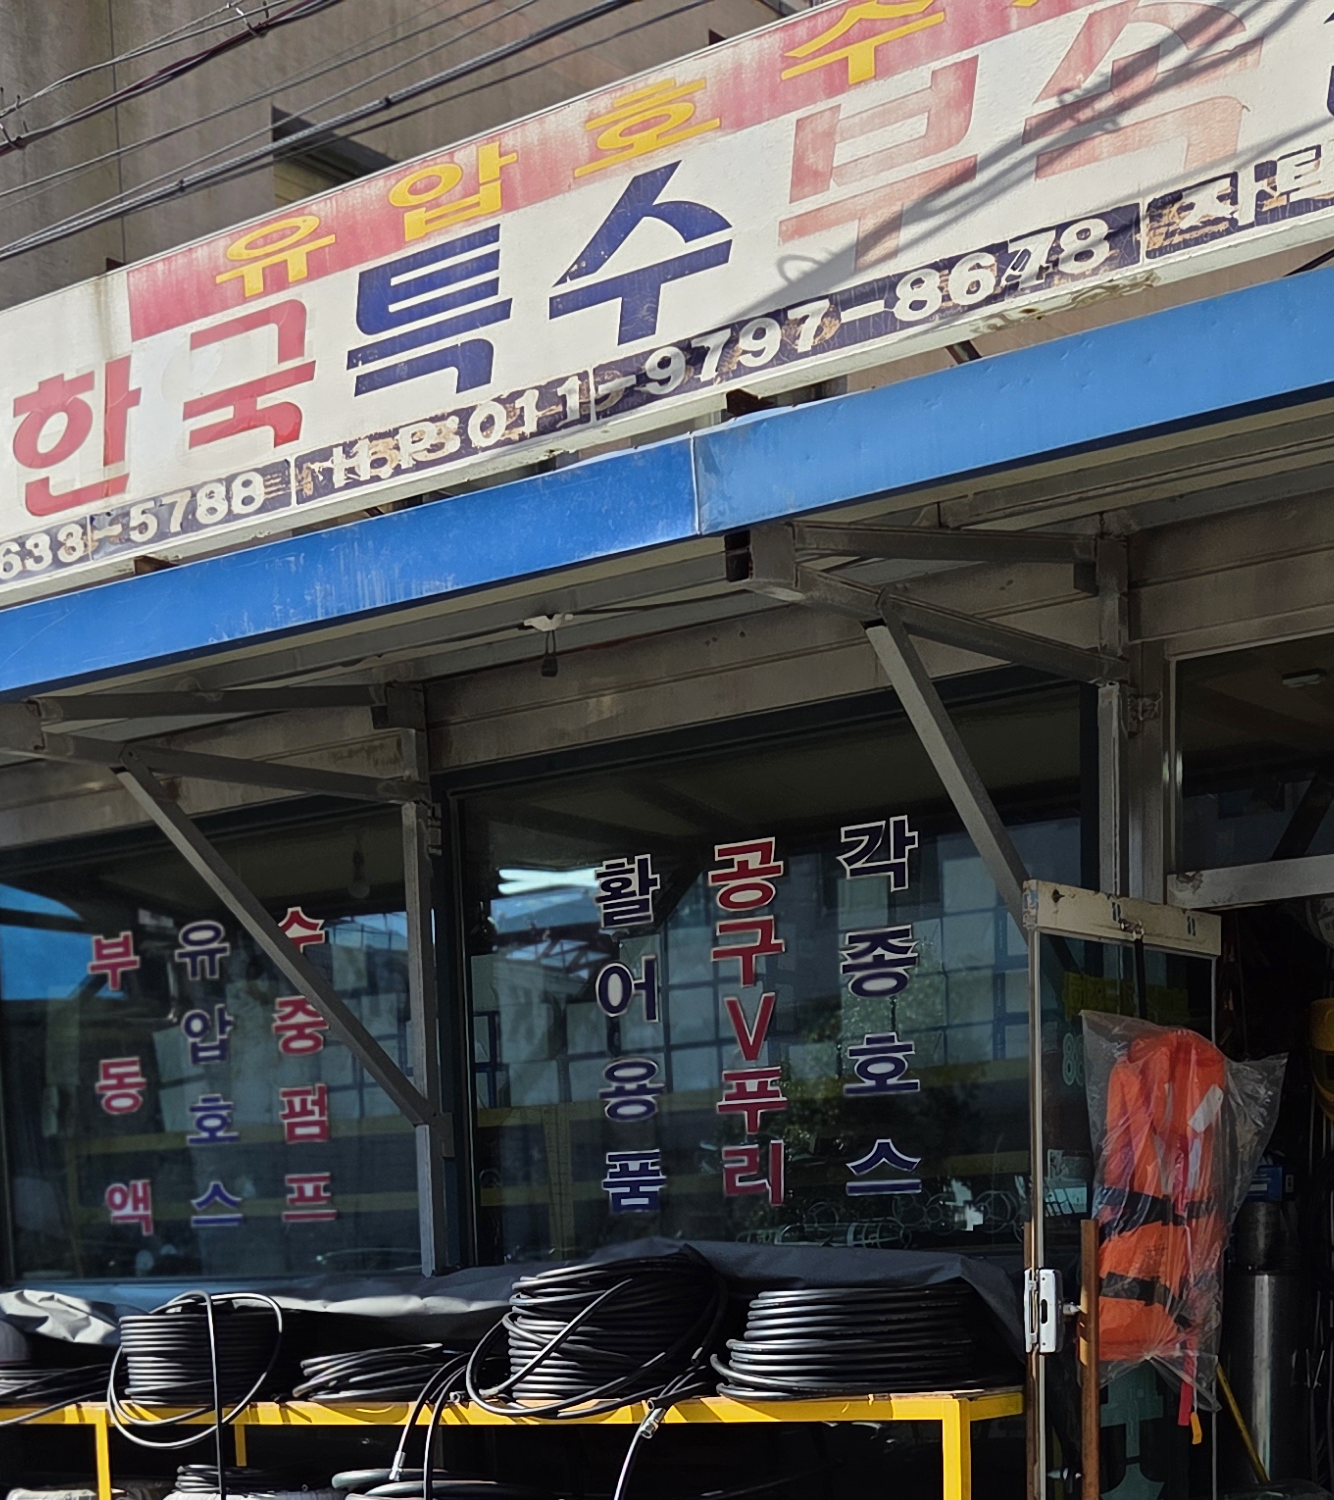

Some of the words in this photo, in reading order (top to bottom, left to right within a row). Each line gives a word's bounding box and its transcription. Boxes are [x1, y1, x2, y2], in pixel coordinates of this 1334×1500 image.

[86, 930, 155, 1236] 부동액
[174, 919, 244, 1227] 유압호스
[272, 906, 339, 1223] 수중펌프
[593, 853, 667, 1214] 활어용품
[708, 835, 788, 1208] 공구V푸리
[837, 814, 923, 1197] 각종호스
